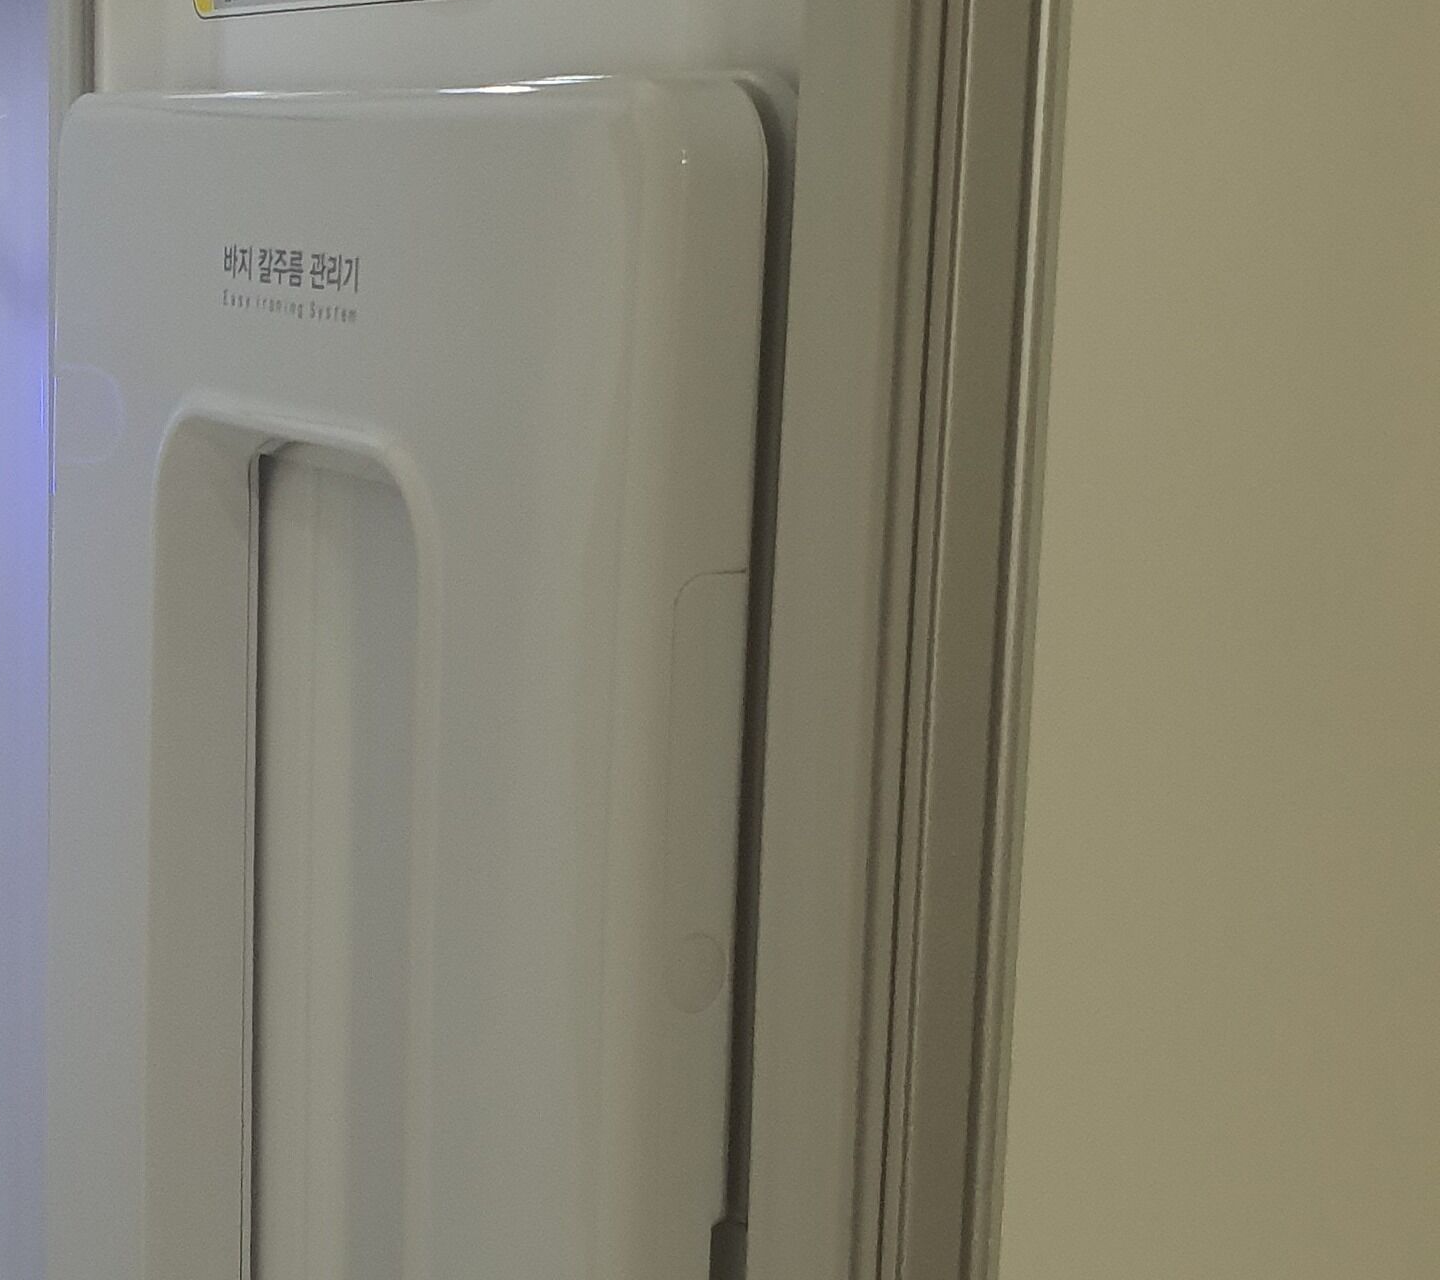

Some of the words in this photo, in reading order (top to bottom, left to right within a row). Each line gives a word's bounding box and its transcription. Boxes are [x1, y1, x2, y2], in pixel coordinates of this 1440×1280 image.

[223, 245, 253, 281] 바지
[258, 248, 304, 288] 칼주름
[310, 253, 360, 293] 관리기
